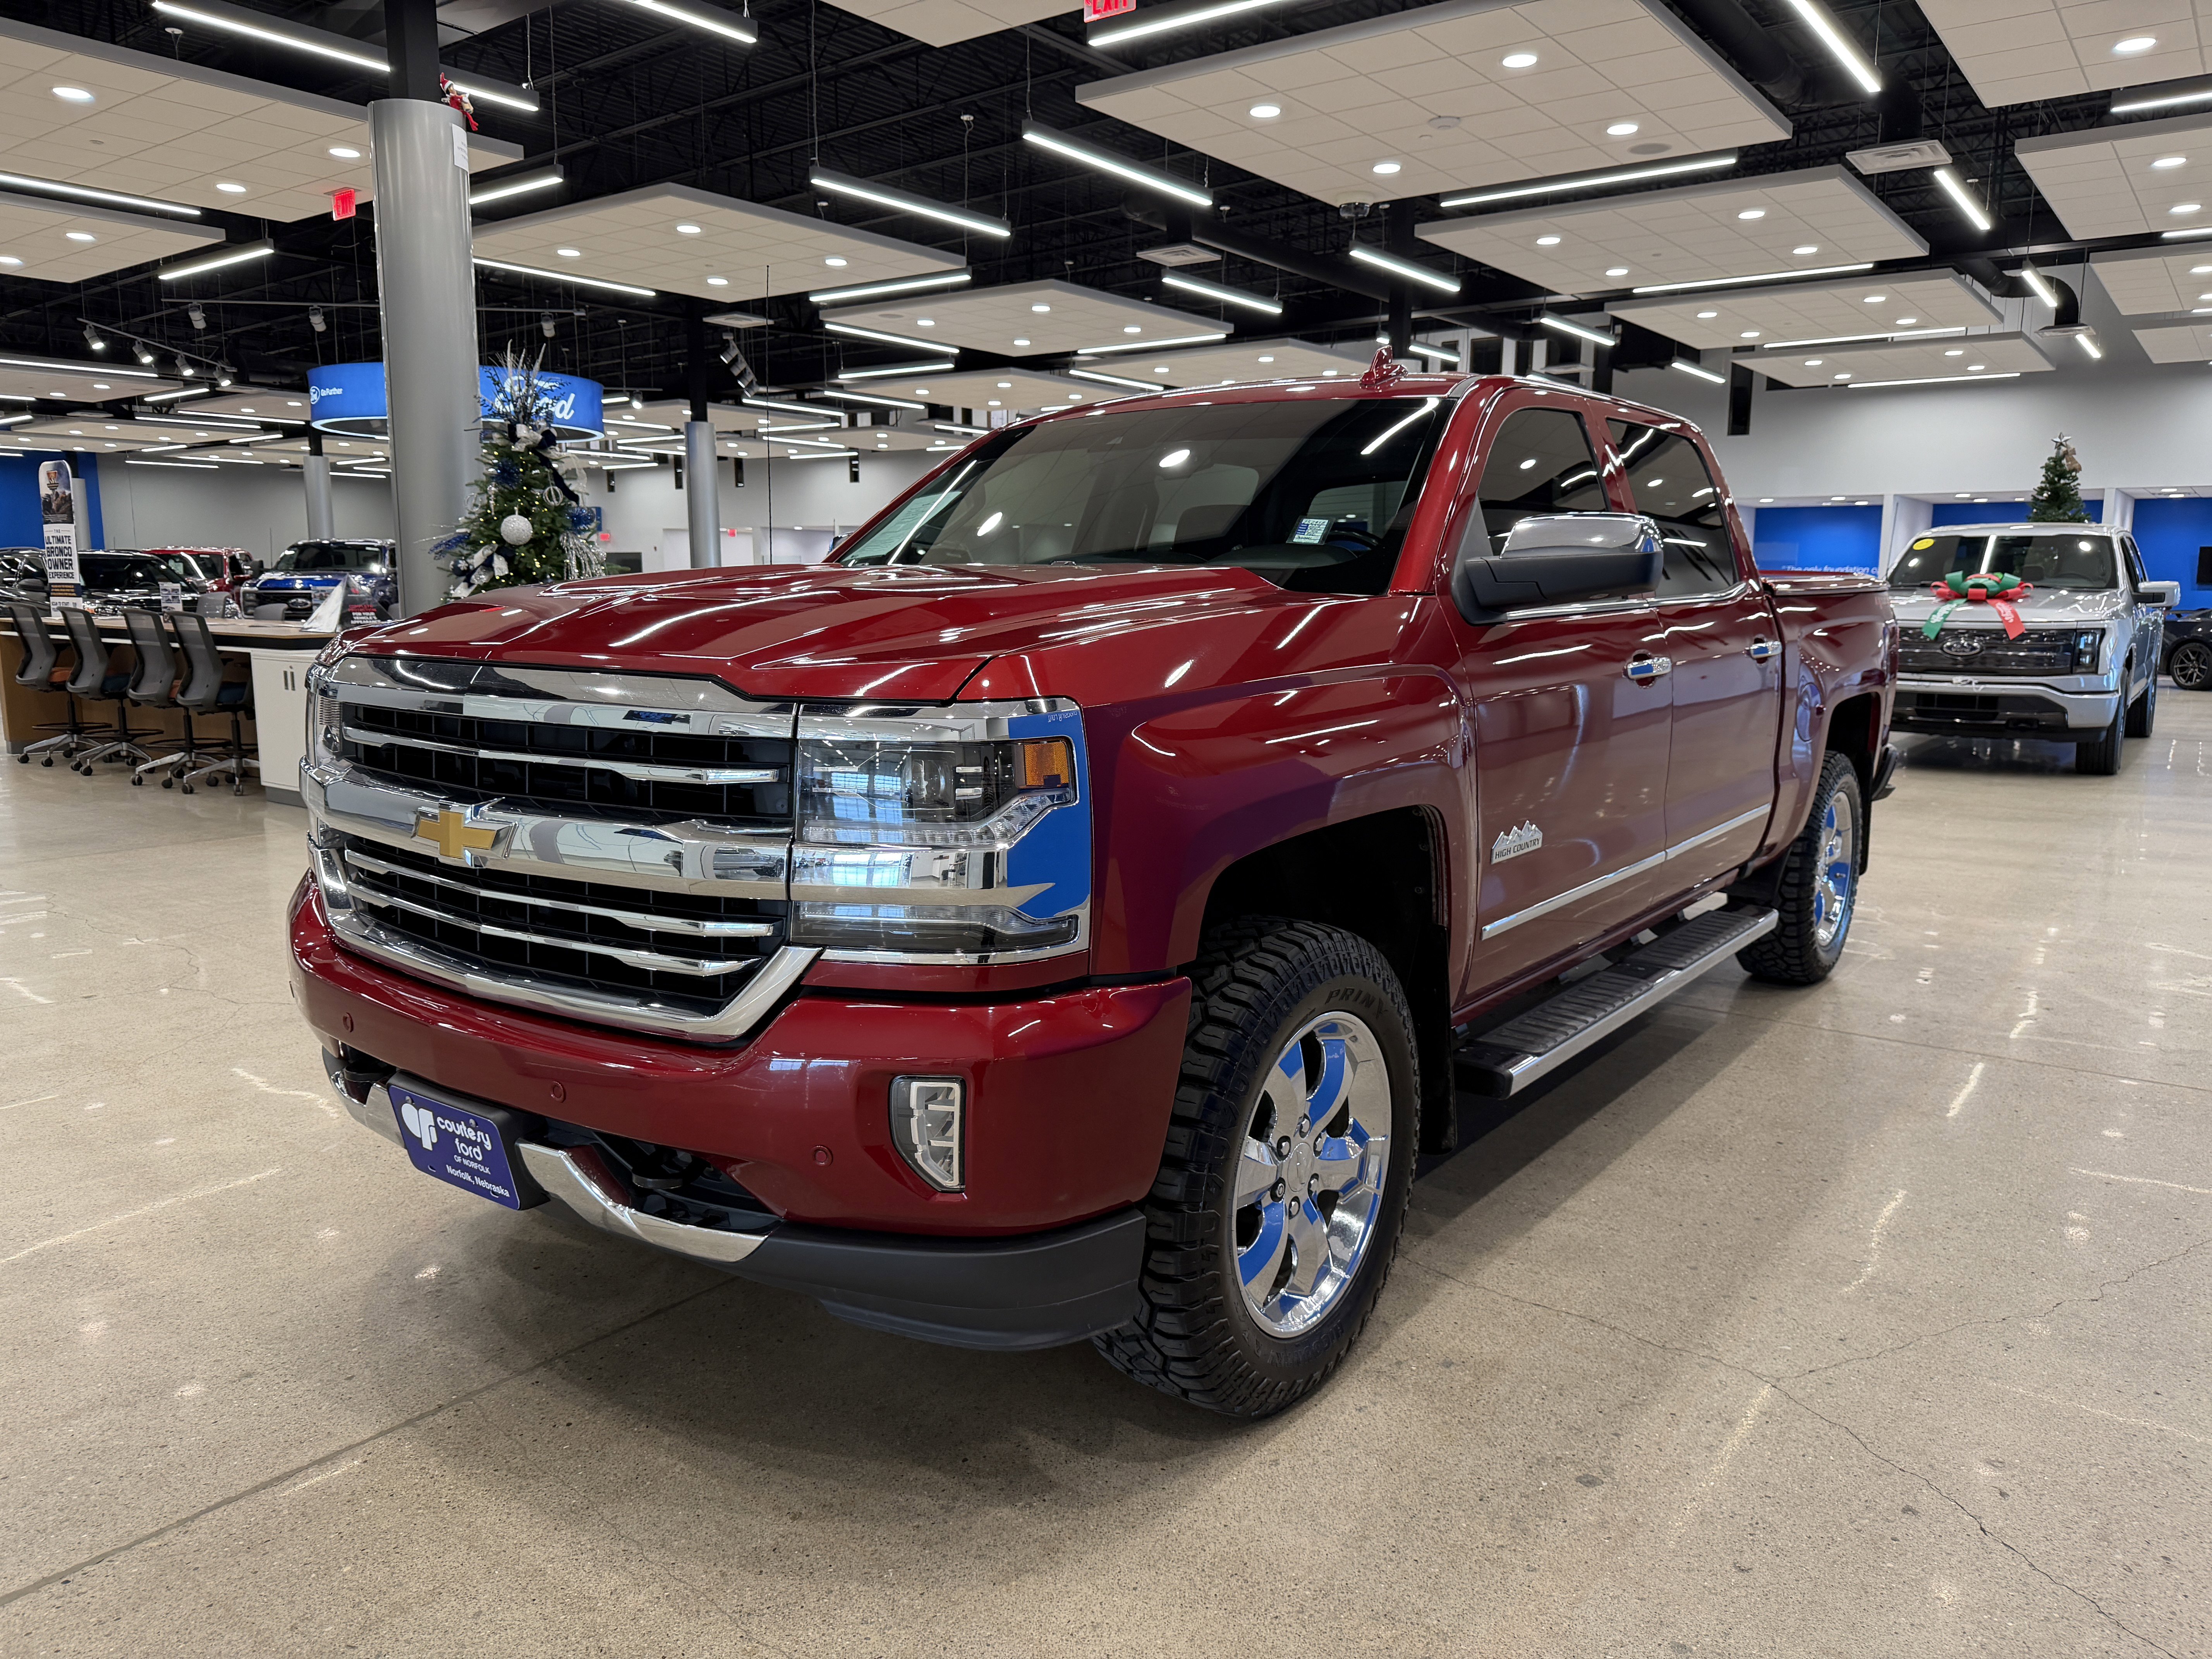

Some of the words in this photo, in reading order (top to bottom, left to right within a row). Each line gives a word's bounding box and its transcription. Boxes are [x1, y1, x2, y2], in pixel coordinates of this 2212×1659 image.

[45, 535, 72, 544] ULTIMATE
[46, 546, 72, 557] BRONCO
[47, 558, 74, 570] OWNER
[1495, 847, 1511, 859] HIGH
[1513, 837, 1540, 853] COUNTRY
[437, 1116, 492, 1151] courtesy
[455, 1138, 483, 1161] ford
[454, 1154, 462, 1163] OF
[462, 1158, 491, 1175] NORFOLK
[446, 1164, 475, 1185] Norfolk,
[474, 1175, 510, 1197] Nebraska
